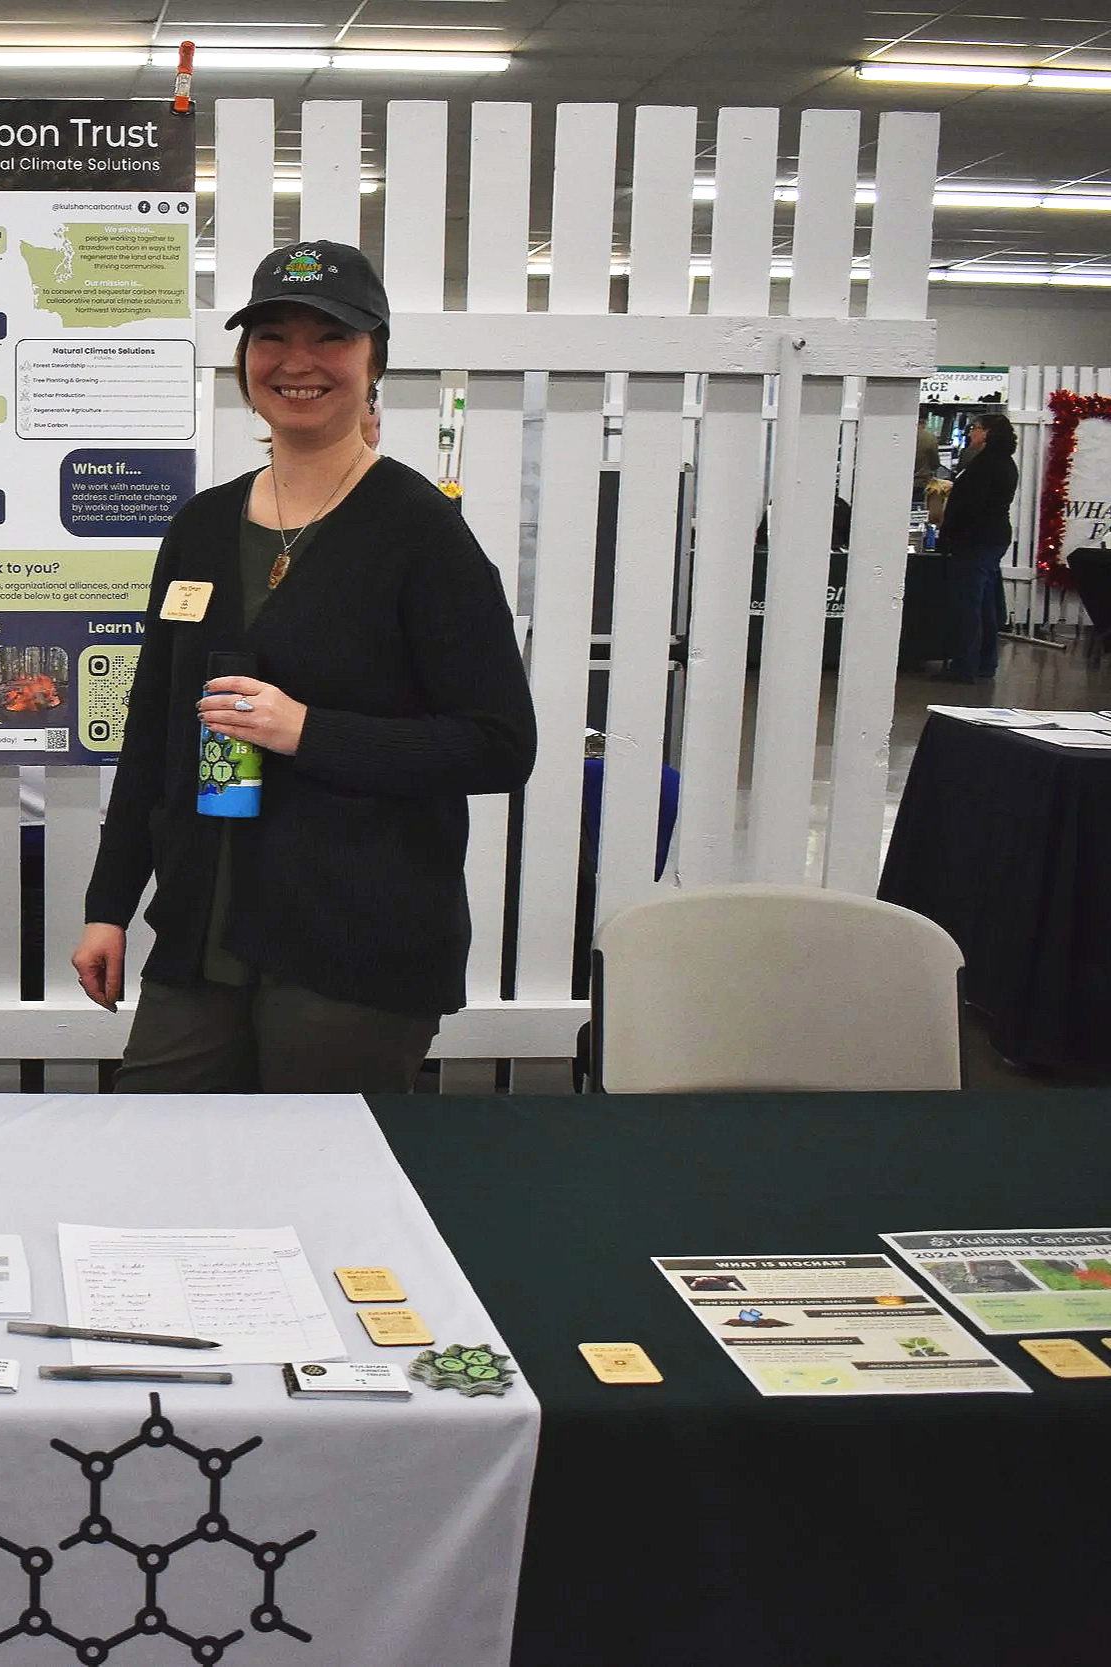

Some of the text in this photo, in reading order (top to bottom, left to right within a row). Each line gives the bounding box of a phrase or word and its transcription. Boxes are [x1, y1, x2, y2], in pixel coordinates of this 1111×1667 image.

[69, 118, 158, 147] Trust
[19, 157, 82, 170] Climate
[88, 157, 159, 170] Solutions
[52, 202, 131, 211] @kulshancarbontrust
[290, 250, 322, 260] LOCAL
[282, 273, 323, 282] ACTION!
[921, 382, 949, 392] AGE
[72, 462, 112, 474] What
[130, 482, 159, 490] nature
[161, 482, 170, 490] to
[71, 493, 107, 502] address
[143, 493, 177, 503] change
[72, 502, 169, 514] by working together to
[72, 512, 103, 522] protect
[105, 512, 136, 521] carbon
[6, 562, 21, 573] to
[25, 562, 59, 577] you?
[88, 621, 145, 633] Learn M
[236, 742, 247, 754] is
[218, 765, 227, 778] T
[954, 1234, 1111, 1246] Kulshan Carbon T
[962, 1250, 1032, 1258] Biochar
[1037, 1249, 1111, 1257] Scale-U
